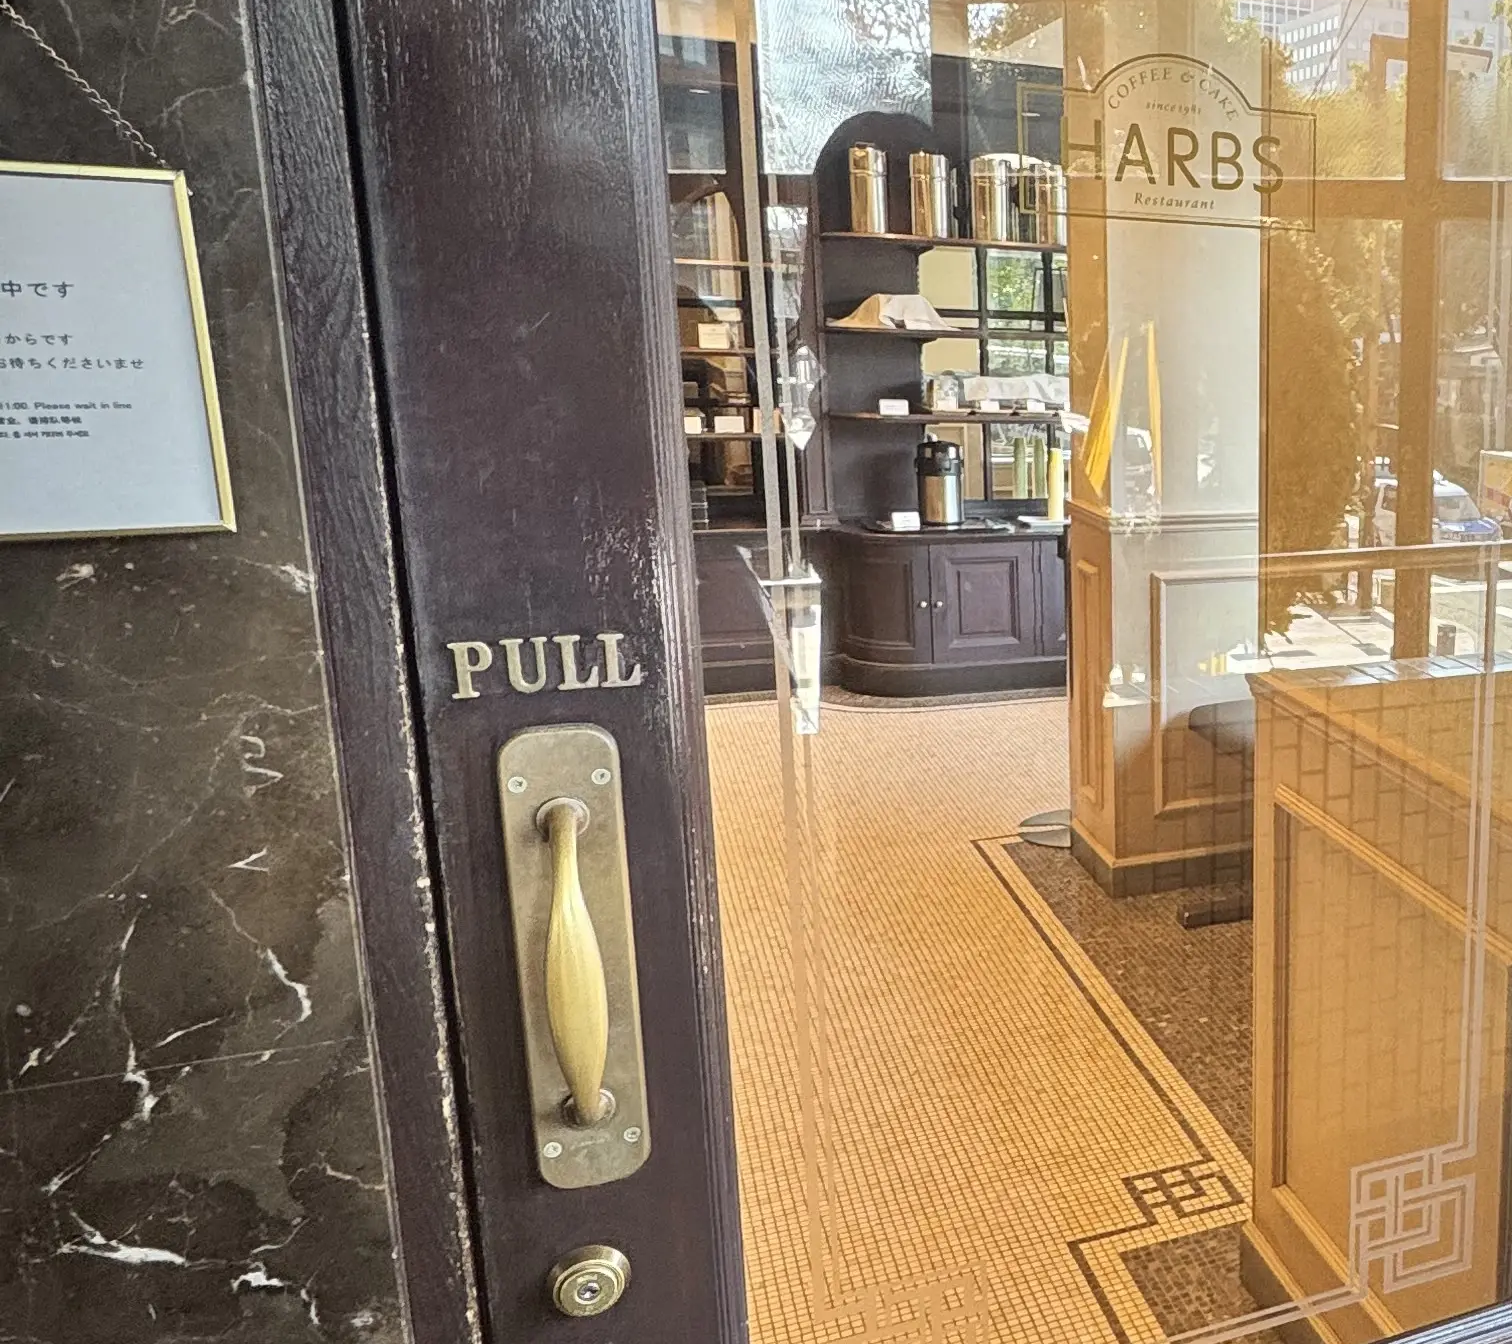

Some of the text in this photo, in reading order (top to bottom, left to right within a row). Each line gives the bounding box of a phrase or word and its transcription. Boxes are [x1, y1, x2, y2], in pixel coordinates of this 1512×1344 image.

[1108, 67, 1240, 122] COFFEE & CAKE
[1145, 100, 1177, 112] since
[1060, 115, 1284, 195] HARBS
[1134, 191, 1215, 211] Restaurant
[0, 280, 75, 298] 中です
[4, 333, 73, 346] からです
[34, 401, 71, 410] Please
[446, 633, 642, 700] PULL
